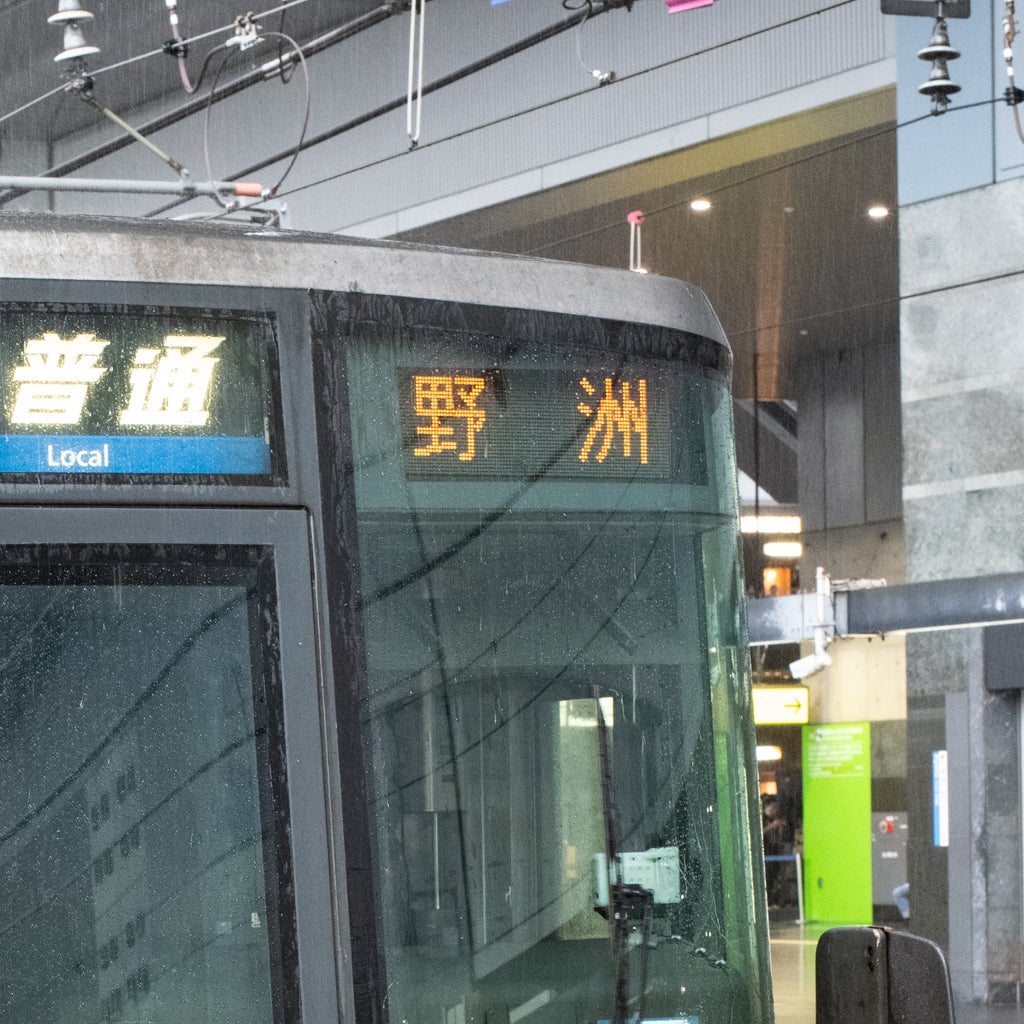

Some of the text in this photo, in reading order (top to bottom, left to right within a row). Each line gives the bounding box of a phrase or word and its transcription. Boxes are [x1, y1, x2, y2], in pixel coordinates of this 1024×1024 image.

[10, 331, 227, 425] 普通
[414, 375, 649, 464] 野洲
[47, 443, 110, 468] Local
